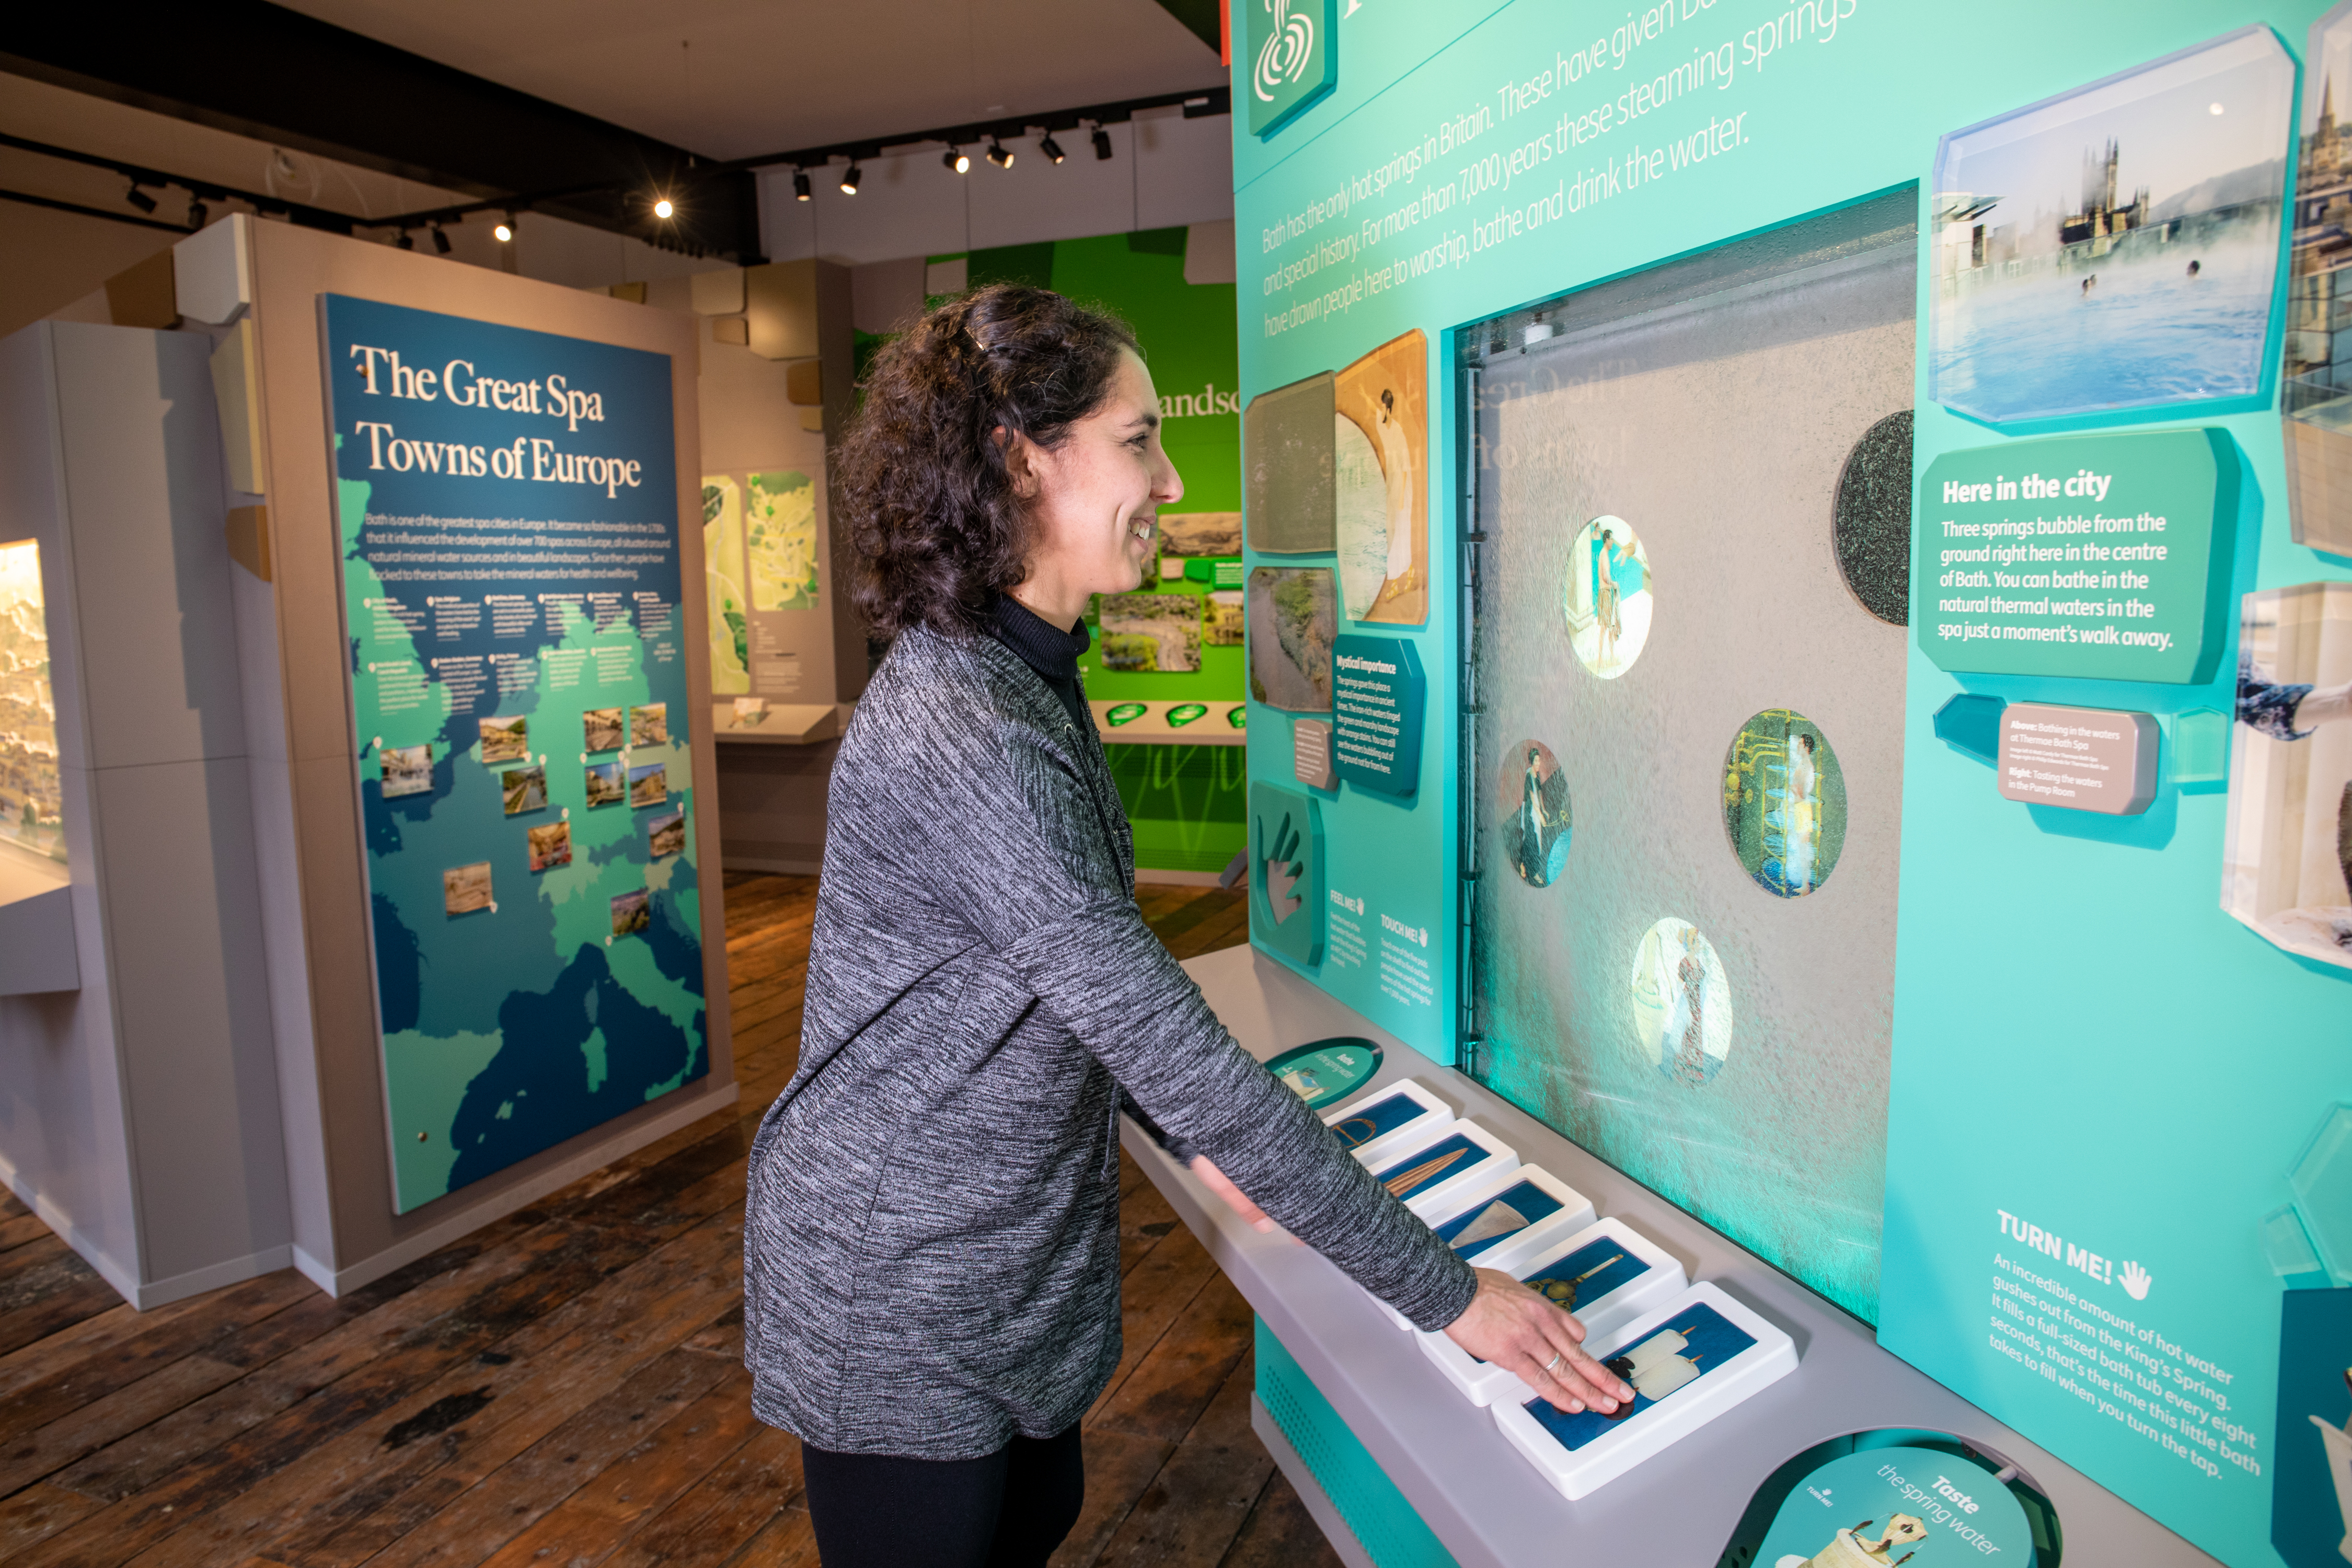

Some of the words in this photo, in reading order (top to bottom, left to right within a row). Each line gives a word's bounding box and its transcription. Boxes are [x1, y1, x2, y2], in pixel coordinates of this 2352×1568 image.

[1263, 219, 1286, 253] Bath
[1287, 213, 1306, 240] has
[1306, 200, 1325, 229] the
[1325, 182, 1351, 218] only
[1352, 169, 1374, 204] hot
[1374, 145, 1422, 198] springs
[1424, 133, 1437, 165] in
[1440, 102, 1494, 155] Britain.
[1497, 70, 1552, 121] These
[1557, 38, 1607, 90] have
[1611, 0, 1674, 71] given
[1263, 262, 1283, 296] and
[1284, 243, 1319, 291] special
[1320, 232, 1361, 268] history.
[1362, 218, 1383, 248] For
[1385, 201, 1420, 238] more
[1421, 182, 1456, 220] than
[1458, 153, 1500, 205] 7,000
[1502, 133, 1552, 191] years
[1555, 103, 1613, 154] these
[1617, 41, 1734, 125] steaming
[1742, 0, 1857, 73] springs
[1264, 312, 1288, 338] have
[1289, 297, 1322, 328] drawn
[1323, 273, 1363, 322] people
[1364, 267, 1392, 297] here
[1393, 258, 1408, 285] to
[1410, 229, 1470, 278] worship,
[1473, 205, 1523, 252] bathe
[1526, 179, 1563, 230] and
[1568, 157, 1621, 213] drink
[1625, 145, 1664, 190] the
[1669, 111, 1749, 171] water.
[350, 344, 437, 401] The
[443, 359, 542, 414] Great
[546, 374, 605, 431] Spa
[1158, 383, 1240, 418] andsc
[355, 421, 488, 477] Towns
[491, 436, 527, 480] of
[529, 438, 641, 499] Europe
[1943, 480, 1993, 504] Here
[1996, 475, 2017, 501] in
[2021, 473, 2061, 500] the
[2064, 469, 2112, 502] city
[1941, 520, 1981, 537] Three
[1981, 518, 2035, 540] springs
[2037, 515, 2092, 535] bubble
[2093, 513, 2134, 533] from
[2136, 512, 2166, 532] the
[1940, 544, 1990, 567] ground
[1992, 544, 2028, 567] right
[2029, 543, 2063, 562] here
[2065, 543, 2081, 561] in
[2082, 542, 2111, 561] the
[2112, 542, 2168, 561] centre
[1940, 569, 1955, 587] of
[1955, 570, 1992, 587] Bath.
[1993, 571, 2020, 588] You
[2022, 574, 2050, 588] can
[2052, 569, 2100, 589] bathe
[2101, 570, 2118, 589] in
[2119, 569, 2149, 590] the
[1939, 595, 1989, 613] natural
[1990, 596, 2049, 615] thermal
[2050, 598, 2105, 617] waters
[2107, 598, 2123, 617] in
[2125, 598, 2155, 618] the
[1938, 624, 1963, 641] spa
[1962, 620, 1990, 642] just
[1990, 626, 2001, 639] a
[2003, 624, 2078, 643] moment’s
[2079, 625, 2120, 645] walk
[2121, 631, 2174, 652] away.
[1336, 655, 1361, 670] Mystical
[1359, 656, 1397, 675] importance
[2010, 720, 2038, 731] Above:
[2037, 723, 2070, 737] Bathing
[2068, 726, 2078, 735] in
[2077, 727, 2092, 737] the
[2091, 730, 2120, 740] waters
[2010, 734, 2019, 742] at
[2019, 734, 2054, 746] Thermae
[2052, 737, 2072, 748] Bath
[2072, 740, 2089, 752] Spa
[2008, 779, 2016, 789] in
[2016, 780, 2029, 791] the
[2028, 782, 2053, 795] Pump
[2051, 786, 2076, 798] Room
[2009, 767, 2032, 779] Right:
[2032, 769, 2061, 785] Tasting
[2060, 774, 2076, 784] the
[2074, 778, 2103, 788] waters
[1330, 889, 1345, 907] FEEL
[1344, 896, 1356, 912] ME!
[1380, 914, 1405, 937] TOUCH
[1404, 926, 1418, 943] ME!
[1336, 1054, 1355, 1066] Bathe
[1997, 1209, 2062, 1261] TURN
[2067, 1242, 2112, 1285] ME!
[1993, 1253, 2011, 1271] An
[2012, 1261, 2077, 1305] incredible
[2078, 1298, 2136, 1336] amount
[2138, 1329, 2155, 1345] of
[2155, 1333, 2183, 1361] hot
[2184, 1352, 2234, 1385] water
[1993, 1276, 2037, 1307] gushes
[2038, 1300, 2062, 1320] out
[2063, 1309, 2096, 1338] from
[2098, 1329, 2123, 1352] the
[2125, 1342, 2171, 1378] King’s
[2172, 1367, 2231, 1411] Spring.
[1992, 1293, 2001, 1309] It
[2002, 1298, 2025, 1321] fills
[2026, 1315, 2035, 1327] a
[2037, 1317, 2097, 1361] full-sized
[2099, 1350, 2134, 1381] bath
[2136, 1371, 2163, 1397] tub
[2164, 1390, 2209, 1424] every
[2211, 1416, 2256, 1449] eight
[1989, 1334, 2023, 1363] takes
[2024, 1354, 2038, 1371] to
[2039, 1362, 2057, 1382] fill
[2058, 1375, 2095, 1405] when
[2097, 1398, 2125, 1422] you
[2127, 1413, 2159, 1442] turn
[2161, 1433, 2188, 1459] the
[2190, 1449, 2222, 1480] tap.
[1990, 1316, 2045, 1356] seconds,
[2046, 1345, 2085, 1377] that’s
[2086, 1367, 2111, 1391] the
[2112, 1381, 2147, 1411] time
[2148, 1402, 2178, 1429] this
[2180, 1418, 2218, 1451] little
[2220, 1440, 2261, 1477] bath
[1806, 1486, 1824, 1500] TURN
[1820, 1497, 1834, 1508] ME!
[1877, 1465, 1905, 1487] the
[1900, 1483, 1953, 1524] spring
[1949, 1517, 2001, 1555] water
[1931, 1475, 1980, 1514] Taste
